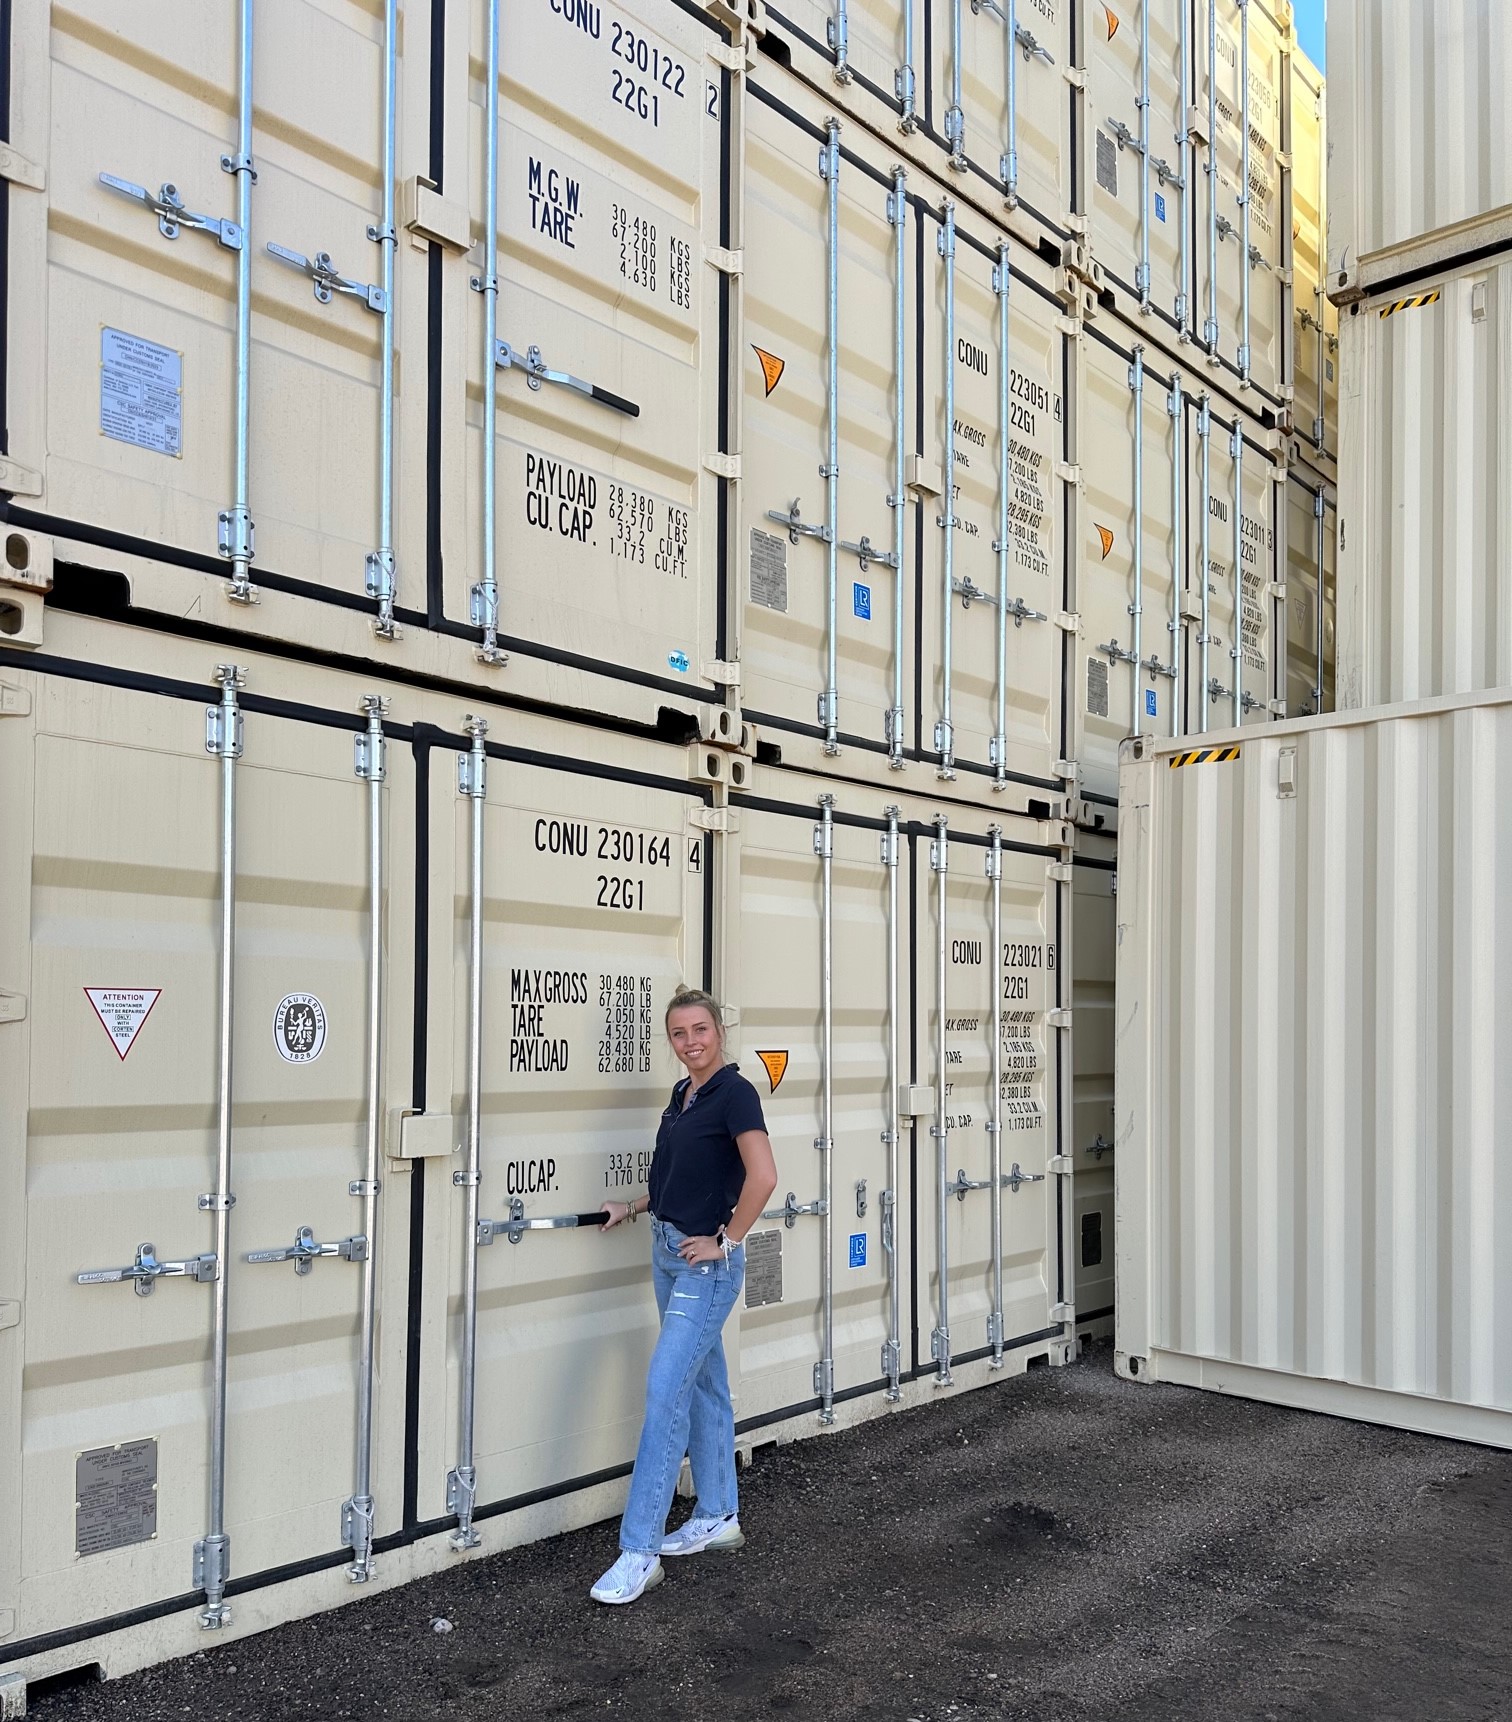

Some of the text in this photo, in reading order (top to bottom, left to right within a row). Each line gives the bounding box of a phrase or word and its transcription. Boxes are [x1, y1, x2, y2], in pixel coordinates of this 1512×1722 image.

[611, 21, 686, 99] 230122
[707, 84, 719, 118] 2
[611, 69, 659, 128] 22G1
[528, 156, 691, 260] M.G.W. 30.480 KGS
[528, 193, 691, 294] TARE 2.100 KGS
[611, 222, 691, 277] 67.200 LBS
[619, 260, 691, 310] 4.630 LBS
[957, 338, 1061, 420] CONU 223051 4
[1010, 401, 1035, 437] 22G1
[1029, 450, 1043, 468] KGS
[1027, 467, 1038, 484] LBS
[526, 452, 688, 530] PAYLOAD 28.380 KGS
[1032, 496, 1044, 513] LBS
[1208, 495, 1228, 523] CONU
[608, 502, 688, 546] 62.570 LBS
[1028, 512, 1042, 529] KGS
[617, 522, 646, 548] 33.2
[1027, 528, 1038, 545] LBS
[610, 537, 646, 565] 1.173
[670, 656, 689, 667] DFIC
[534, 818, 700, 871] CONU 230164 4
[596, 875, 644, 911] 22G1
[952, 940, 1054, 968] CONU 223021 6
[599, 974, 635, 992] 30.480
[640, 976, 652, 992] KG
[1003, 976, 1028, 999] 22G1
[102, 993, 144, 1001] ATTENTION
[599, 992, 651, 1008] 67.200 LB
[277, 997, 323, 1030] BUREAU VERITAS
[511, 1004, 652, 1038] TARE 2.050 KG
[1022, 1011, 1036, 1023] KGS
[605, 1025, 651, 1040] 4.520 LB
[1020, 1026, 1031, 1038] LBS
[510, 1039, 651, 1072] PAYLOAD 28.430 KG
[598, 1057, 650, 1073] 62.680 LB
[1026, 1056, 1037, 1068] LBS
[1022, 1072, 1035, 1083] KGS
[1020, 1086, 1031, 1099] LBS
[609, 1153, 632, 1170] 33.2
[604, 1170, 632, 1187] 1.170
